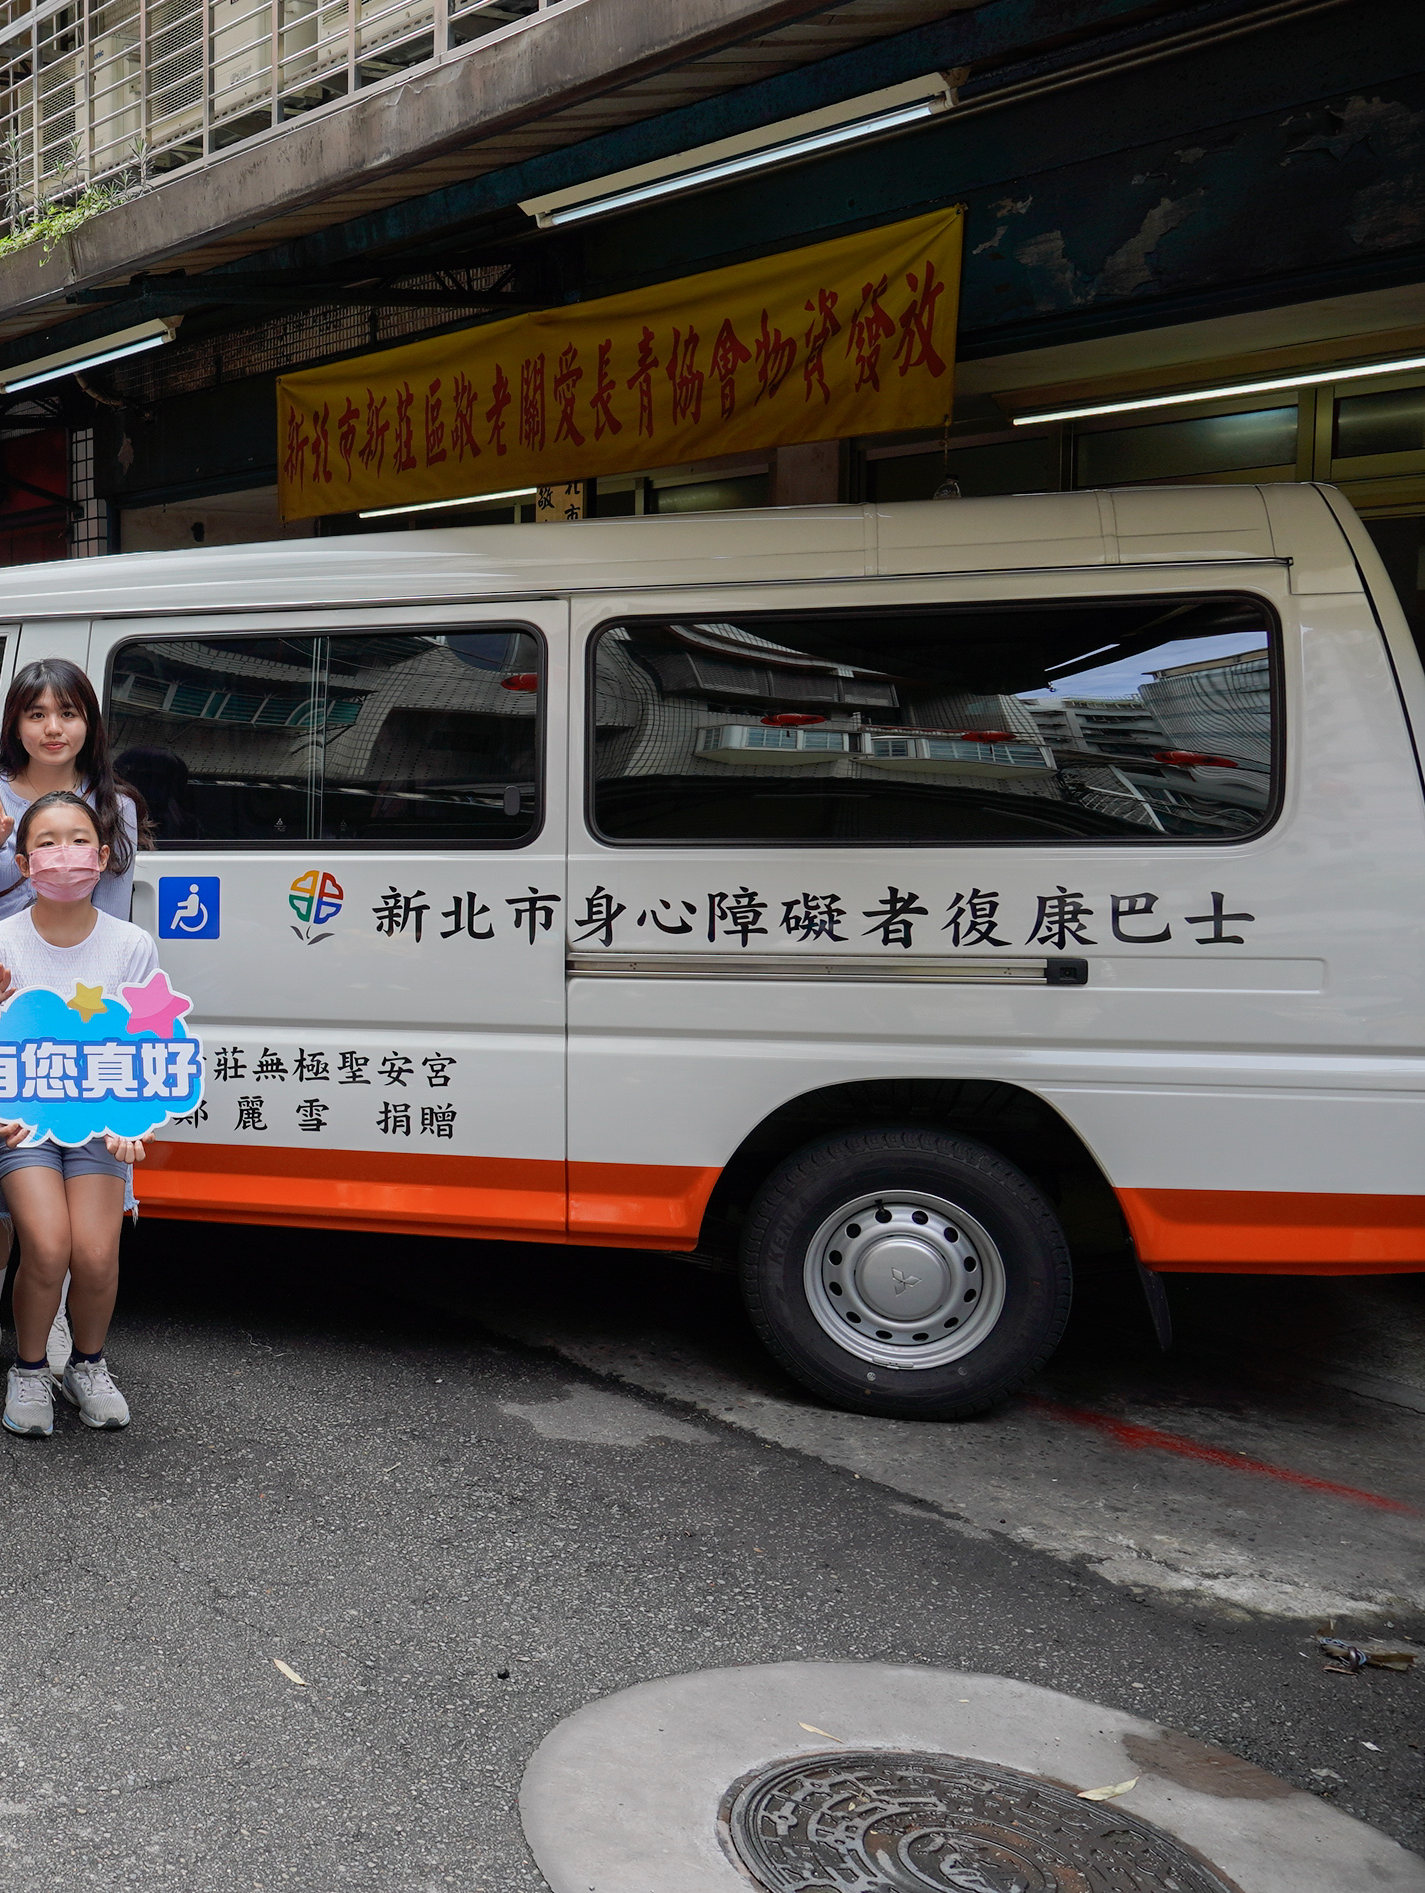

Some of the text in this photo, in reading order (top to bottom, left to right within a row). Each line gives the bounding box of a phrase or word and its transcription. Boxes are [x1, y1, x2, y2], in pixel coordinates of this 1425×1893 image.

[283, 259, 947, 492] 新北市新莊區敬老關愛長青協會物資發放
[371, 885, 1256, 949] 新北市身心障礙者復康巴士
[202, 1046, 457, 1088] 莊無極聖安宮
[376, 1101, 458, 1140] 捐贈
